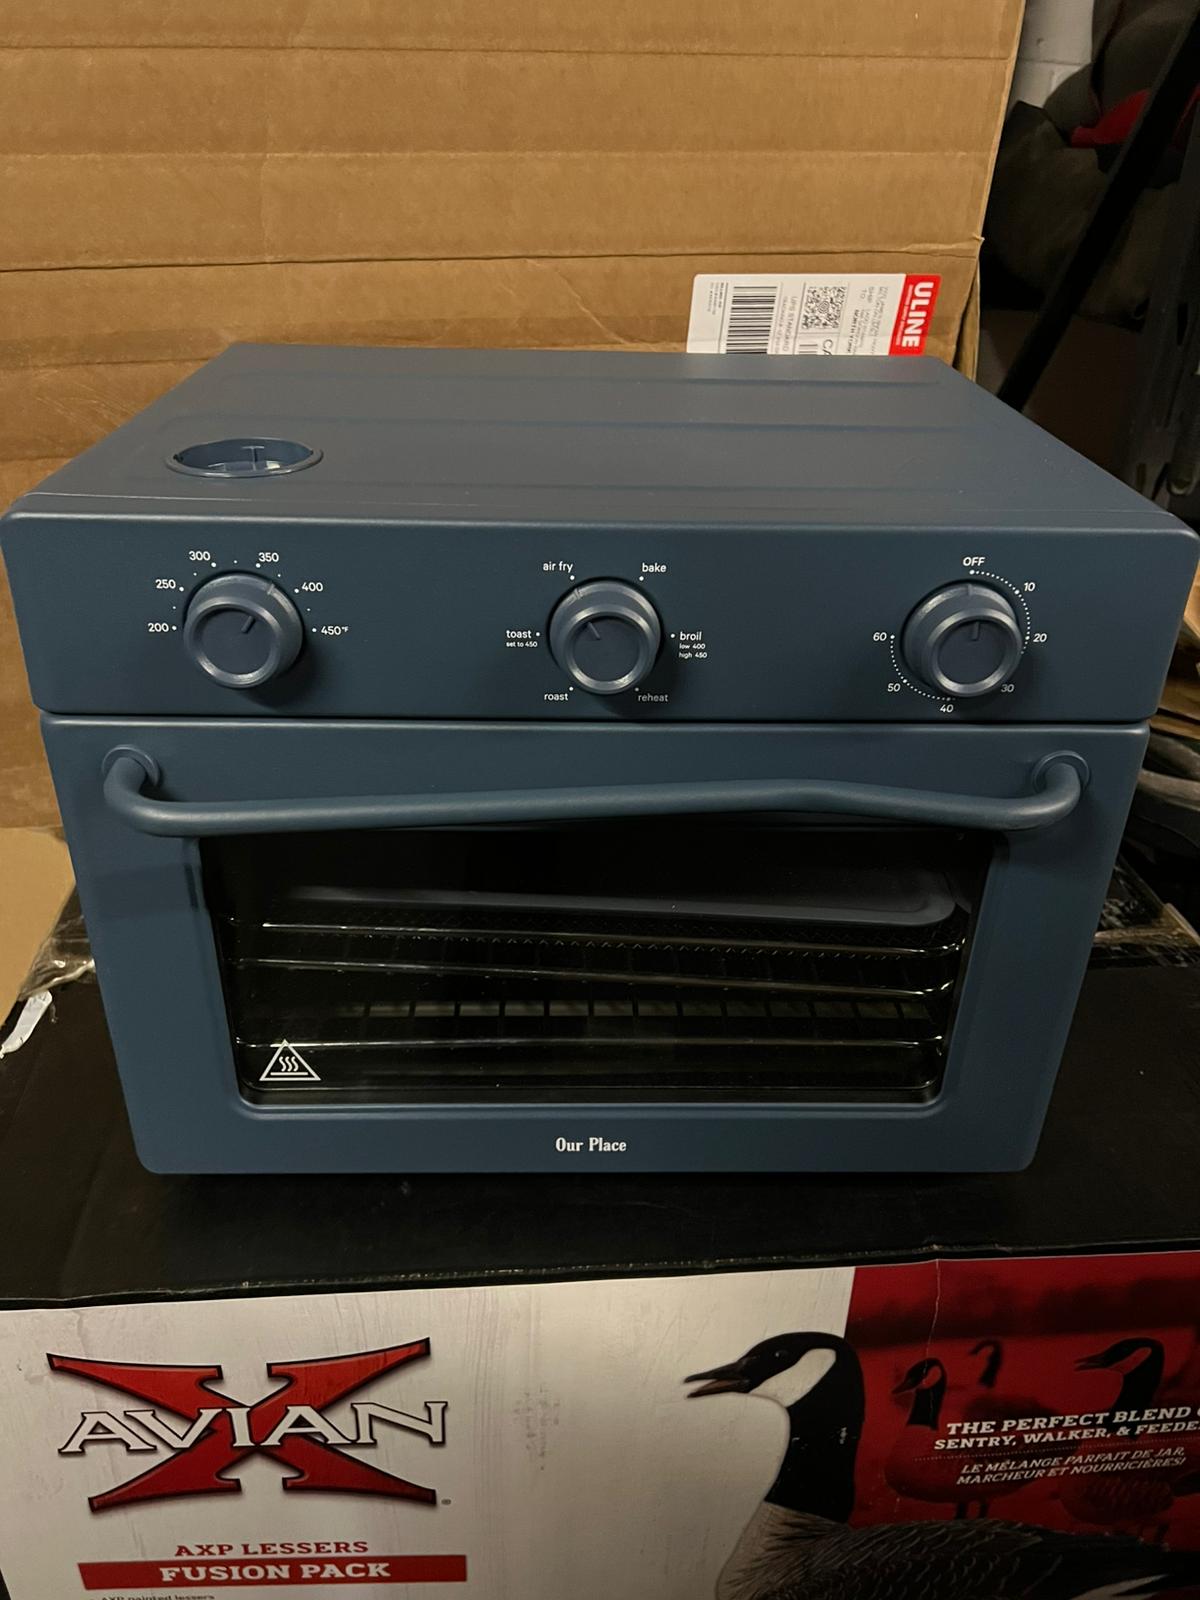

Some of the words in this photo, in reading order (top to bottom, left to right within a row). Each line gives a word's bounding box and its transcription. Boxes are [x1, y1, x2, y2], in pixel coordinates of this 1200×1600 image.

[902, 282, 934, 348] ULINE
[782, 313, 795, 352] STANDARD
[189, 551, 211, 561] 300
[258, 552, 280, 562] 350
[962, 556, 986, 567] OFF
[542, 561, 556, 572] air
[558, 561, 573, 574] fry
[641, 562, 667, 573] bake
[155, 579, 176, 589] 250
[301, 582, 324, 592] 400
[1023, 582, 1036, 592] 10
[148, 623, 169, 633] 200
[506, 629, 532, 639] toast
[679, 631, 702, 641] broil
[872, 632, 887, 641] 60
[1033, 633, 1047, 642] 20
[679, 651, 693, 659] high
[887, 683, 901, 692] 50
[1001, 684, 1015, 693] 30
[544, 692, 569, 701] roast
[638, 693, 668, 702] reheat
[939, 704, 954, 713] 40
[555, 1137, 584, 1152] Our
[588, 1137, 627, 1152] Place
[946, 1421, 997, 1435] THE
[1001, 1412, 1110, 1432] PERFECT
[1112, 1406, 1192, 1424] BLEND
[58, 1400, 448, 1455] AVIAN
[934, 1435, 1016, 1450] SENTRY,
[1023, 1427, 1112, 1444] WALKER,
[1116, 1425, 1131, 1436] &
[1134, 1420, 1200, 1435] FEEDE
[961, 1464, 983, 1475] LE
[984, 1457, 1064, 1473] MÉLANGE
[1064, 1450, 1131, 1466] PARFAIT
[1130, 1448, 1155, 1460] DE
[956, 1468, 1047, 1485] MARCHEUR
[1046, 1466, 1071, 1478] ET
[174, 1543, 234, 1557] AXP
[241, 1541, 369, 1555] LESSERS
[159, 1564, 291, 1582] FUSION
[300, 1562, 392, 1579] PACK
